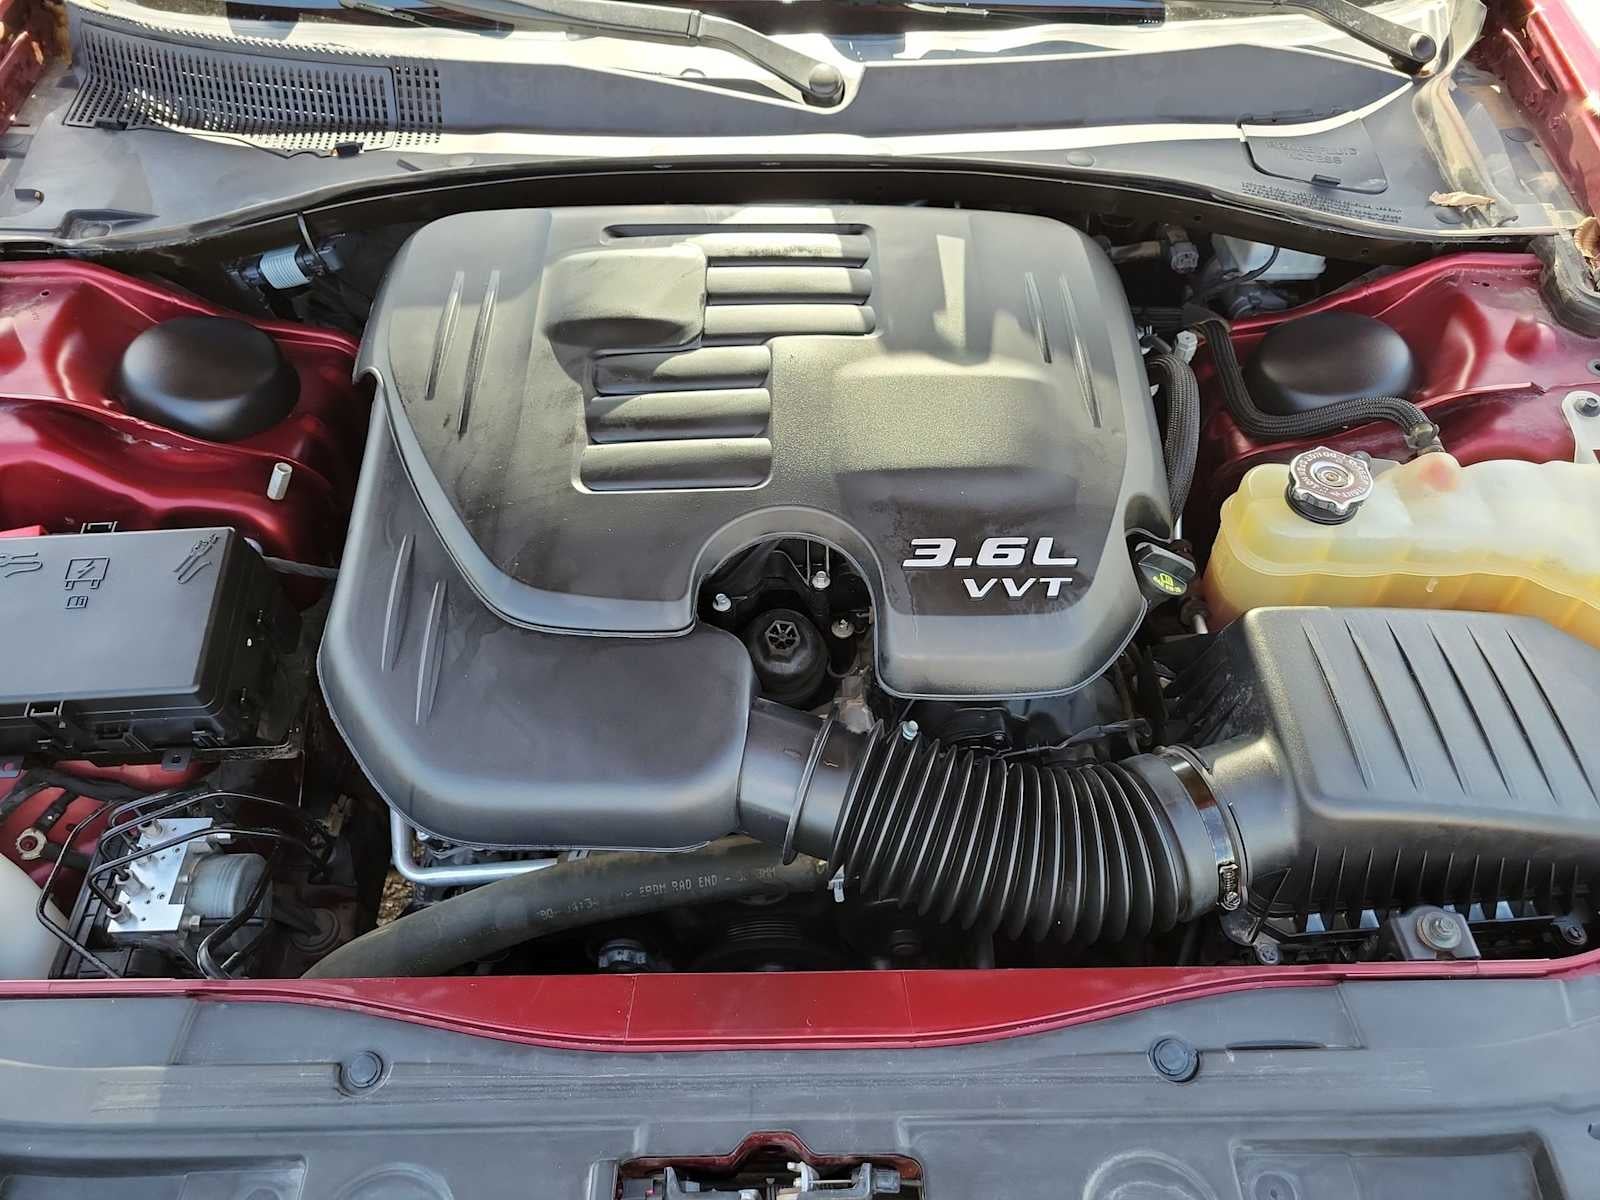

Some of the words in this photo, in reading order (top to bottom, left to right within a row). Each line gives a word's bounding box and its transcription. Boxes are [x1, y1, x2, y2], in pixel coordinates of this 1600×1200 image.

[902, 536, 1078, 568] 3.6L
[962, 576, 1074, 599] VVT
[698, 874, 718, 889] END
